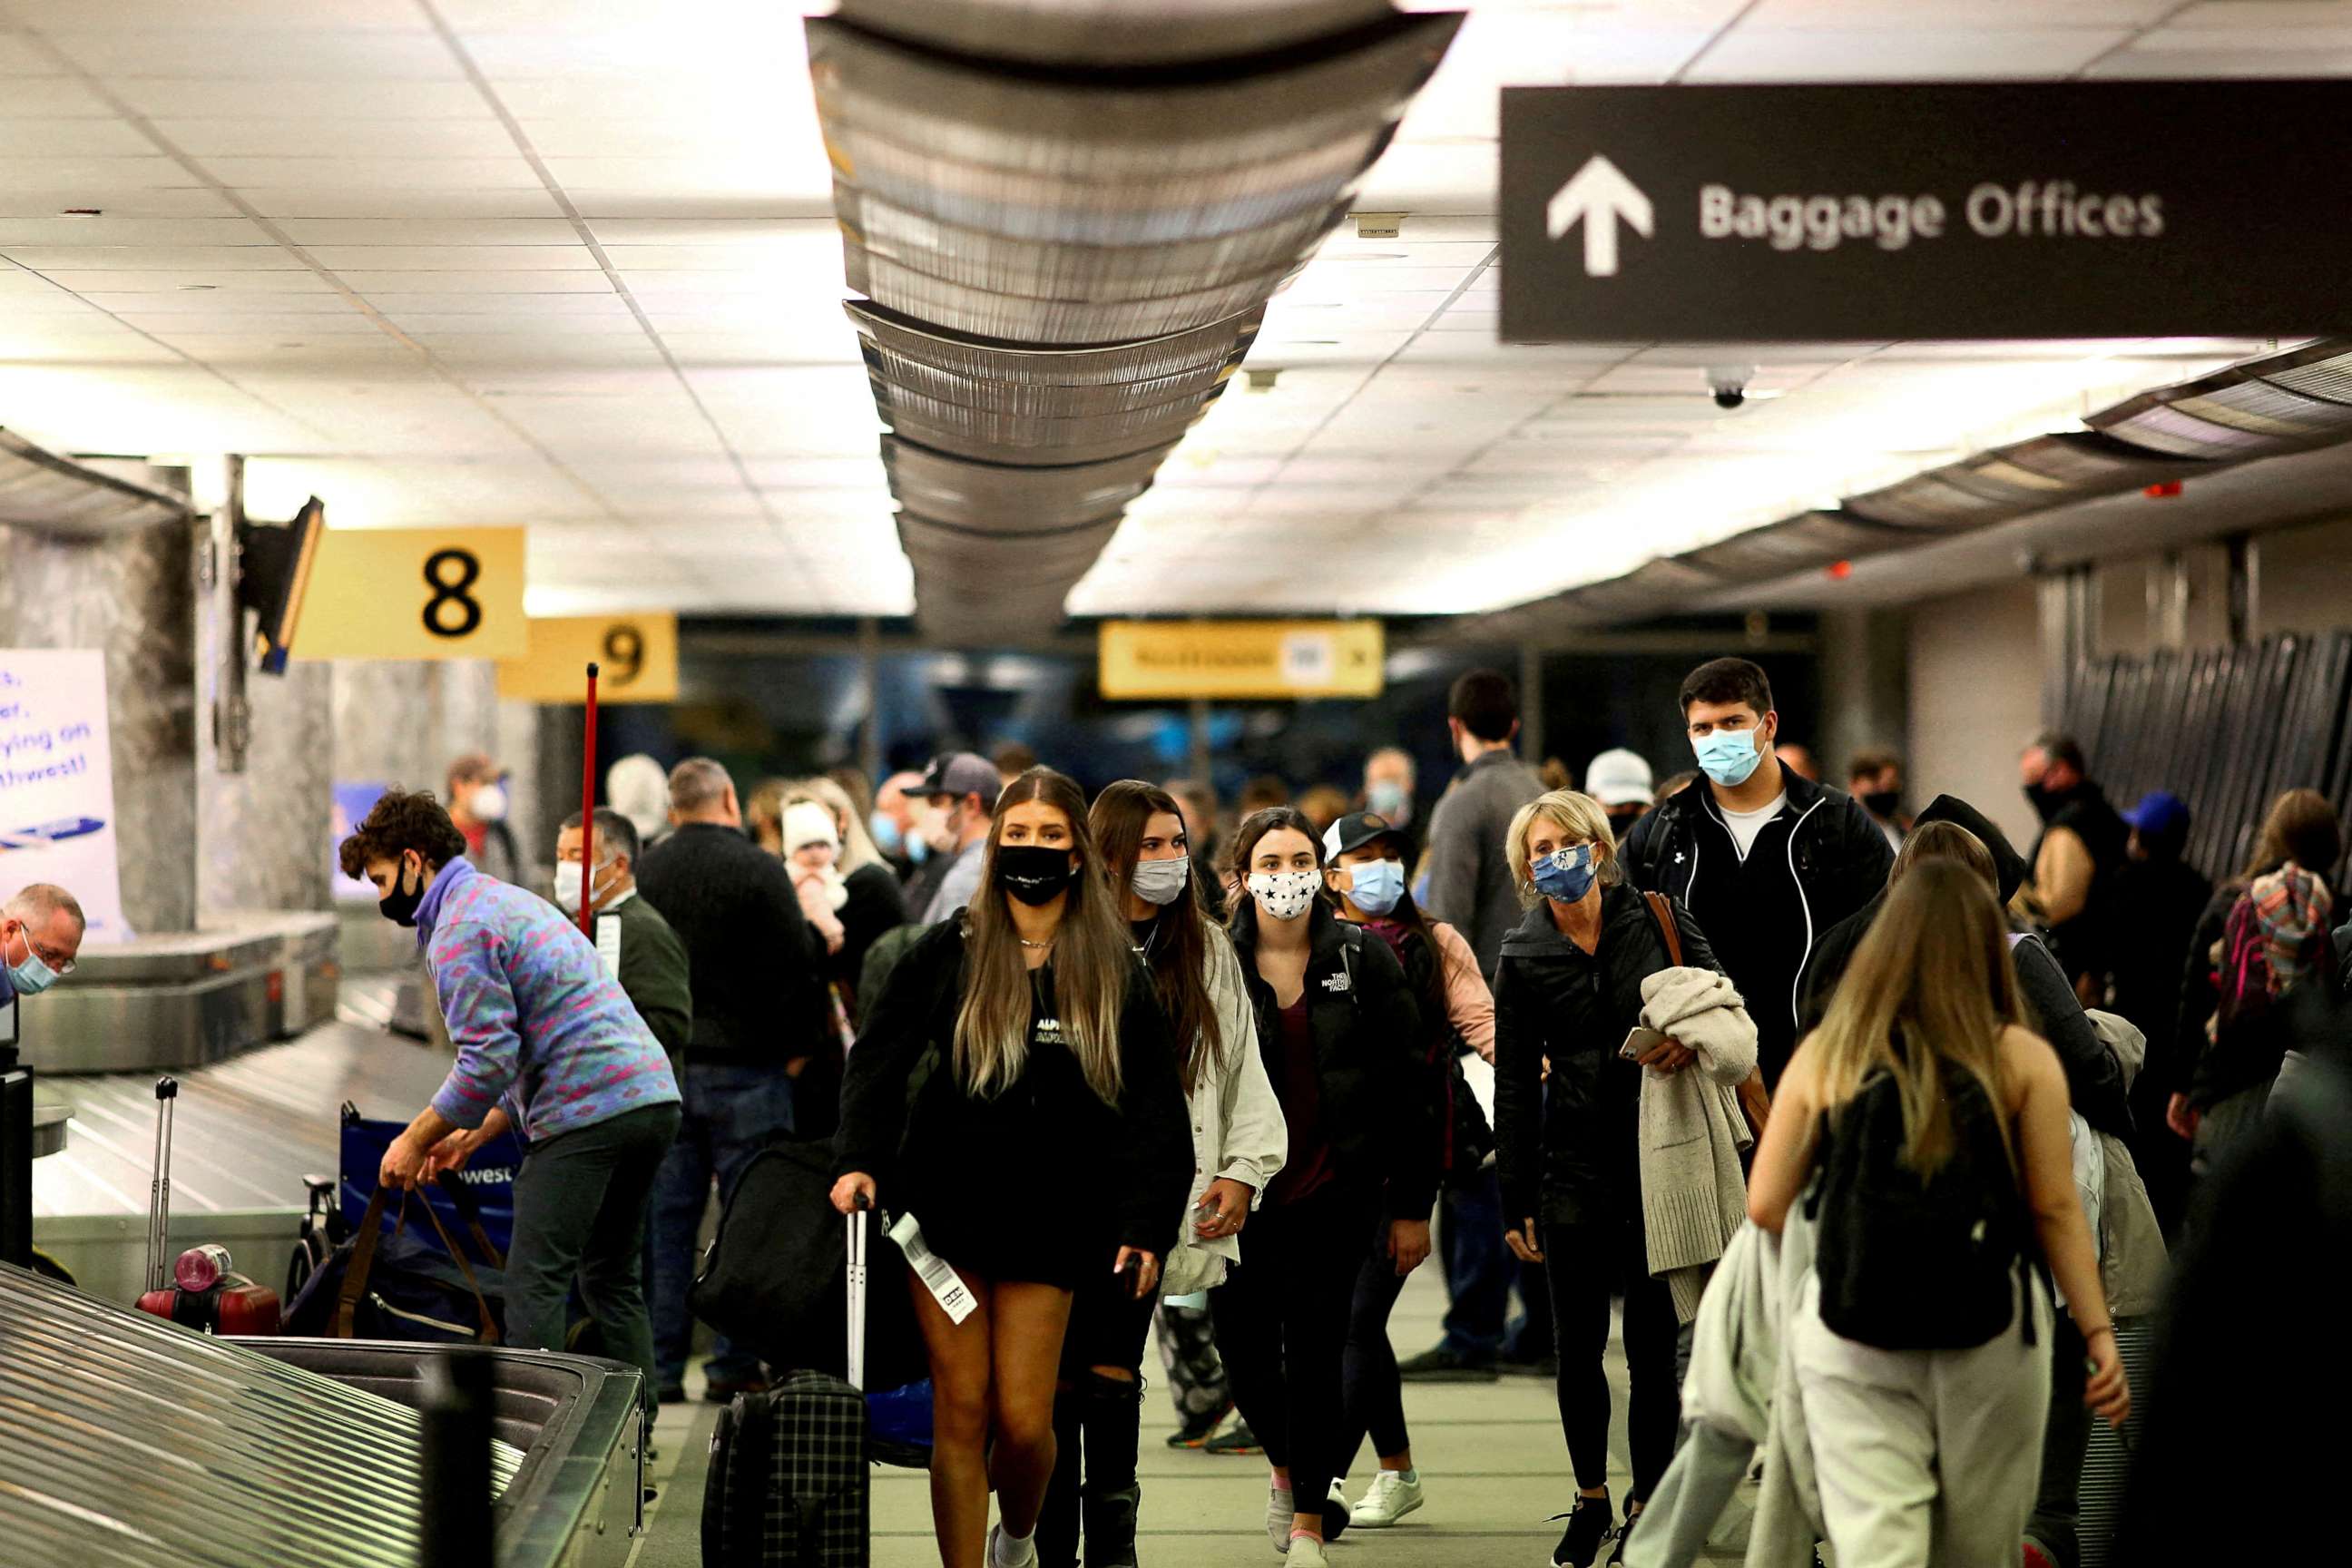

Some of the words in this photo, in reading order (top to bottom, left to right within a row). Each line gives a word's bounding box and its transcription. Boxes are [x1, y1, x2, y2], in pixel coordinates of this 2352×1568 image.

[1699, 185, 1945, 250] Baggage
[1966, 181, 2164, 238] Offices
[422, 546, 482, 638] 8
[601, 624, 644, 687] 9
[60, 722, 91, 741] on
[1321, 979, 1345, 987] NORTH
[458, 1167, 513, 1184] west
[944, 1287, 964, 1306] DEN
